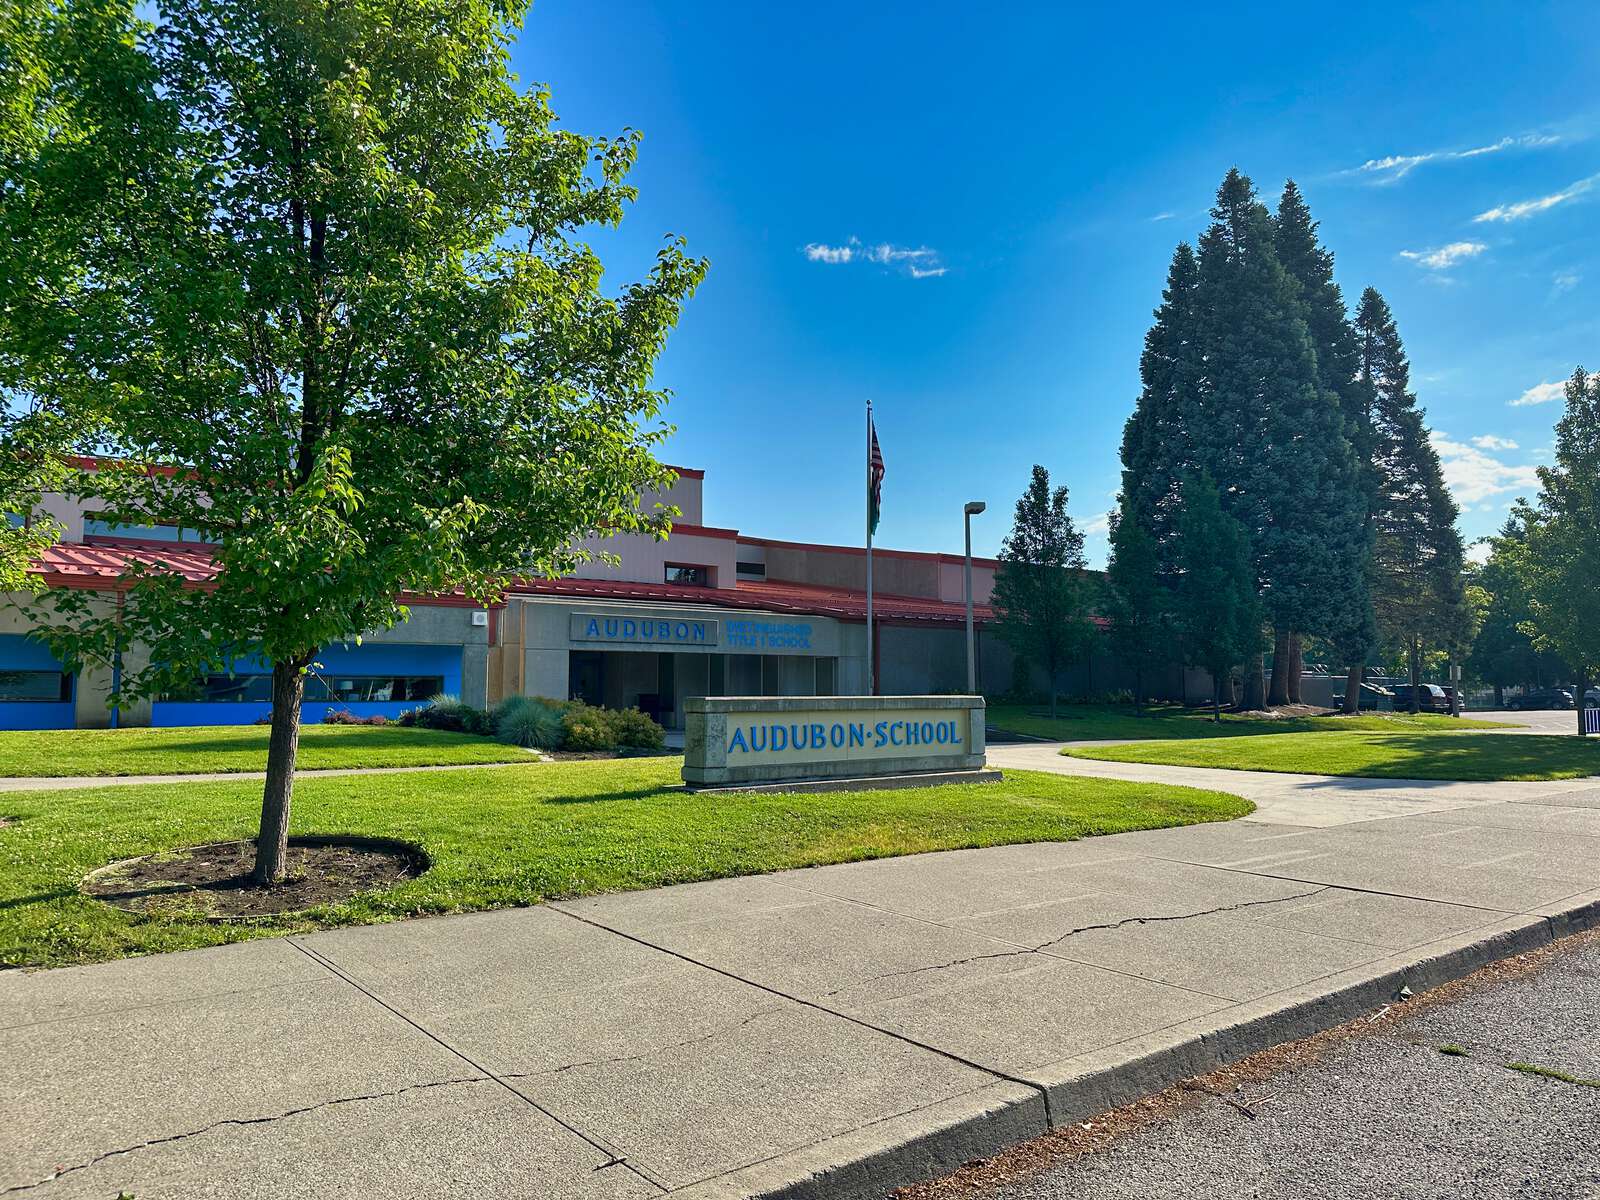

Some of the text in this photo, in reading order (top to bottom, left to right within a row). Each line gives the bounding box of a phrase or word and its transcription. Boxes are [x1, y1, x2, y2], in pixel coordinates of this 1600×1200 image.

[586, 618, 706, 641] AUDUBON
[768, 636, 811, 649] SCHOOL
[728, 720, 963, 753] AUDUBON SCHOOL
